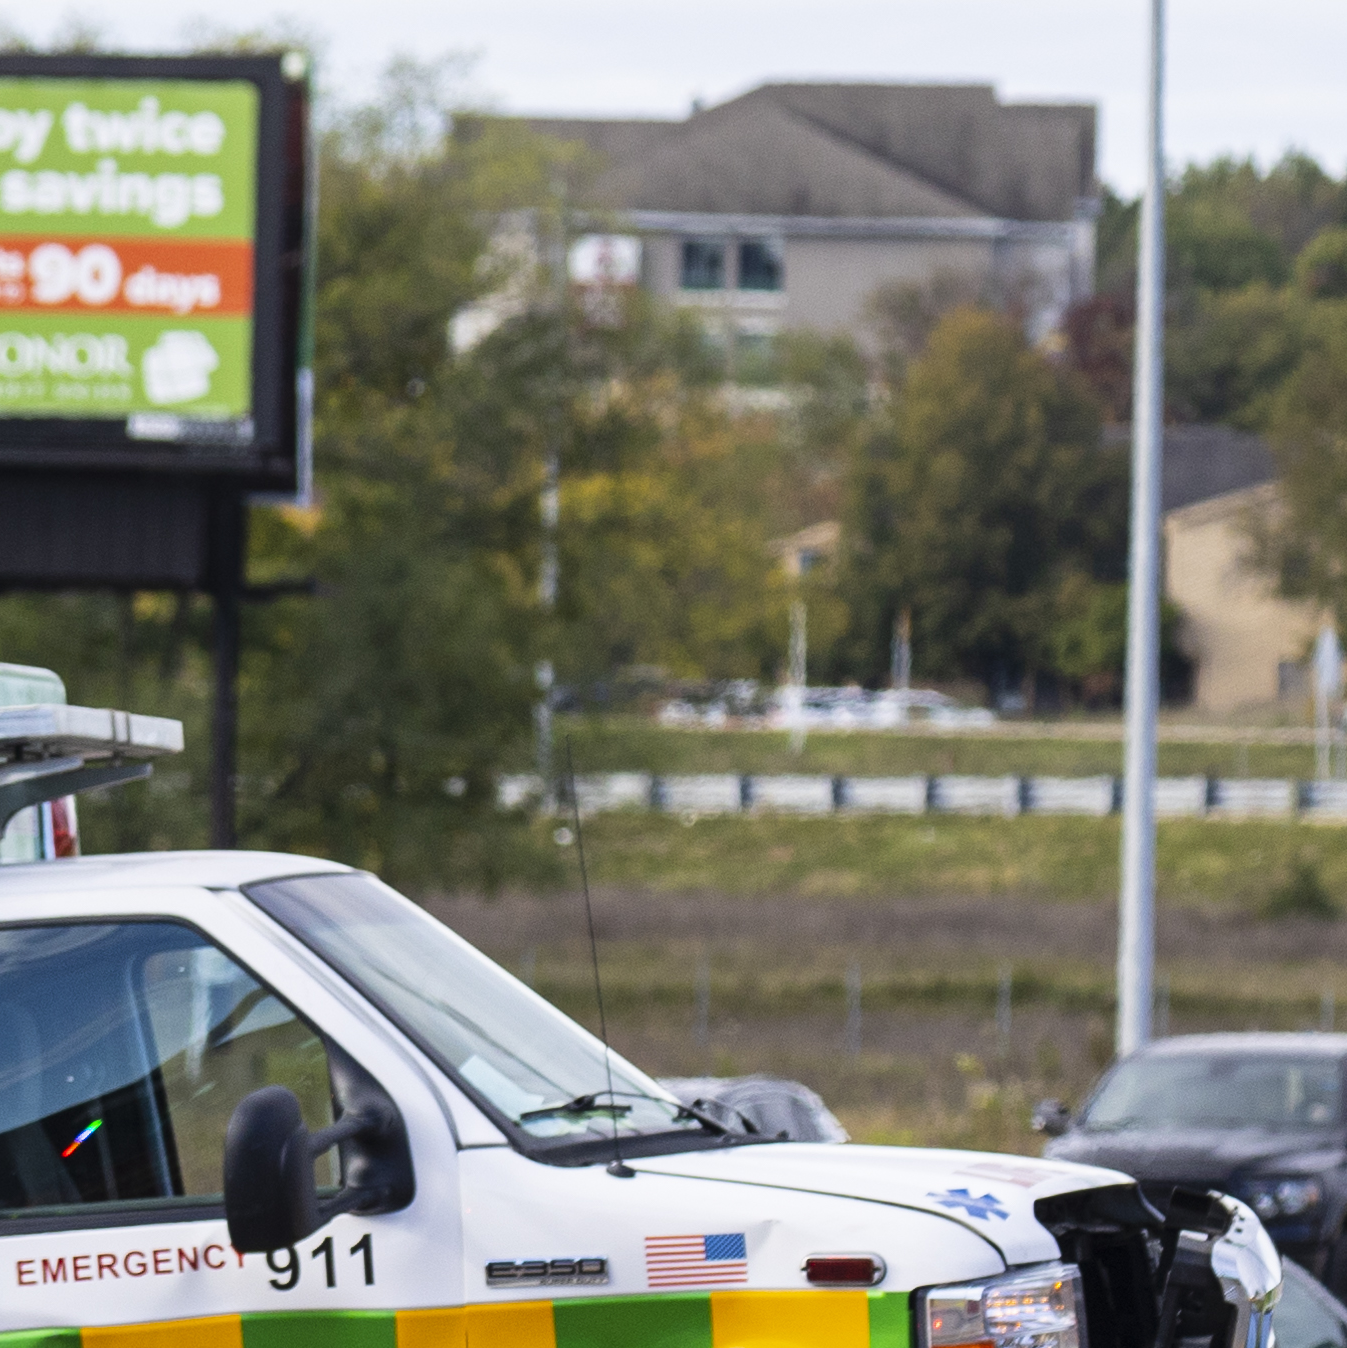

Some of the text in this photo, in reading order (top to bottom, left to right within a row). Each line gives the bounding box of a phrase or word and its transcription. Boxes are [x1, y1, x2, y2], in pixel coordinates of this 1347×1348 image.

[62, 97, 224, 156] twice
[0, 159, 224, 228] savings
[29, 243, 220, 313] 90 days
[17, 1233, 376, 1291] EMERGENCY 911
